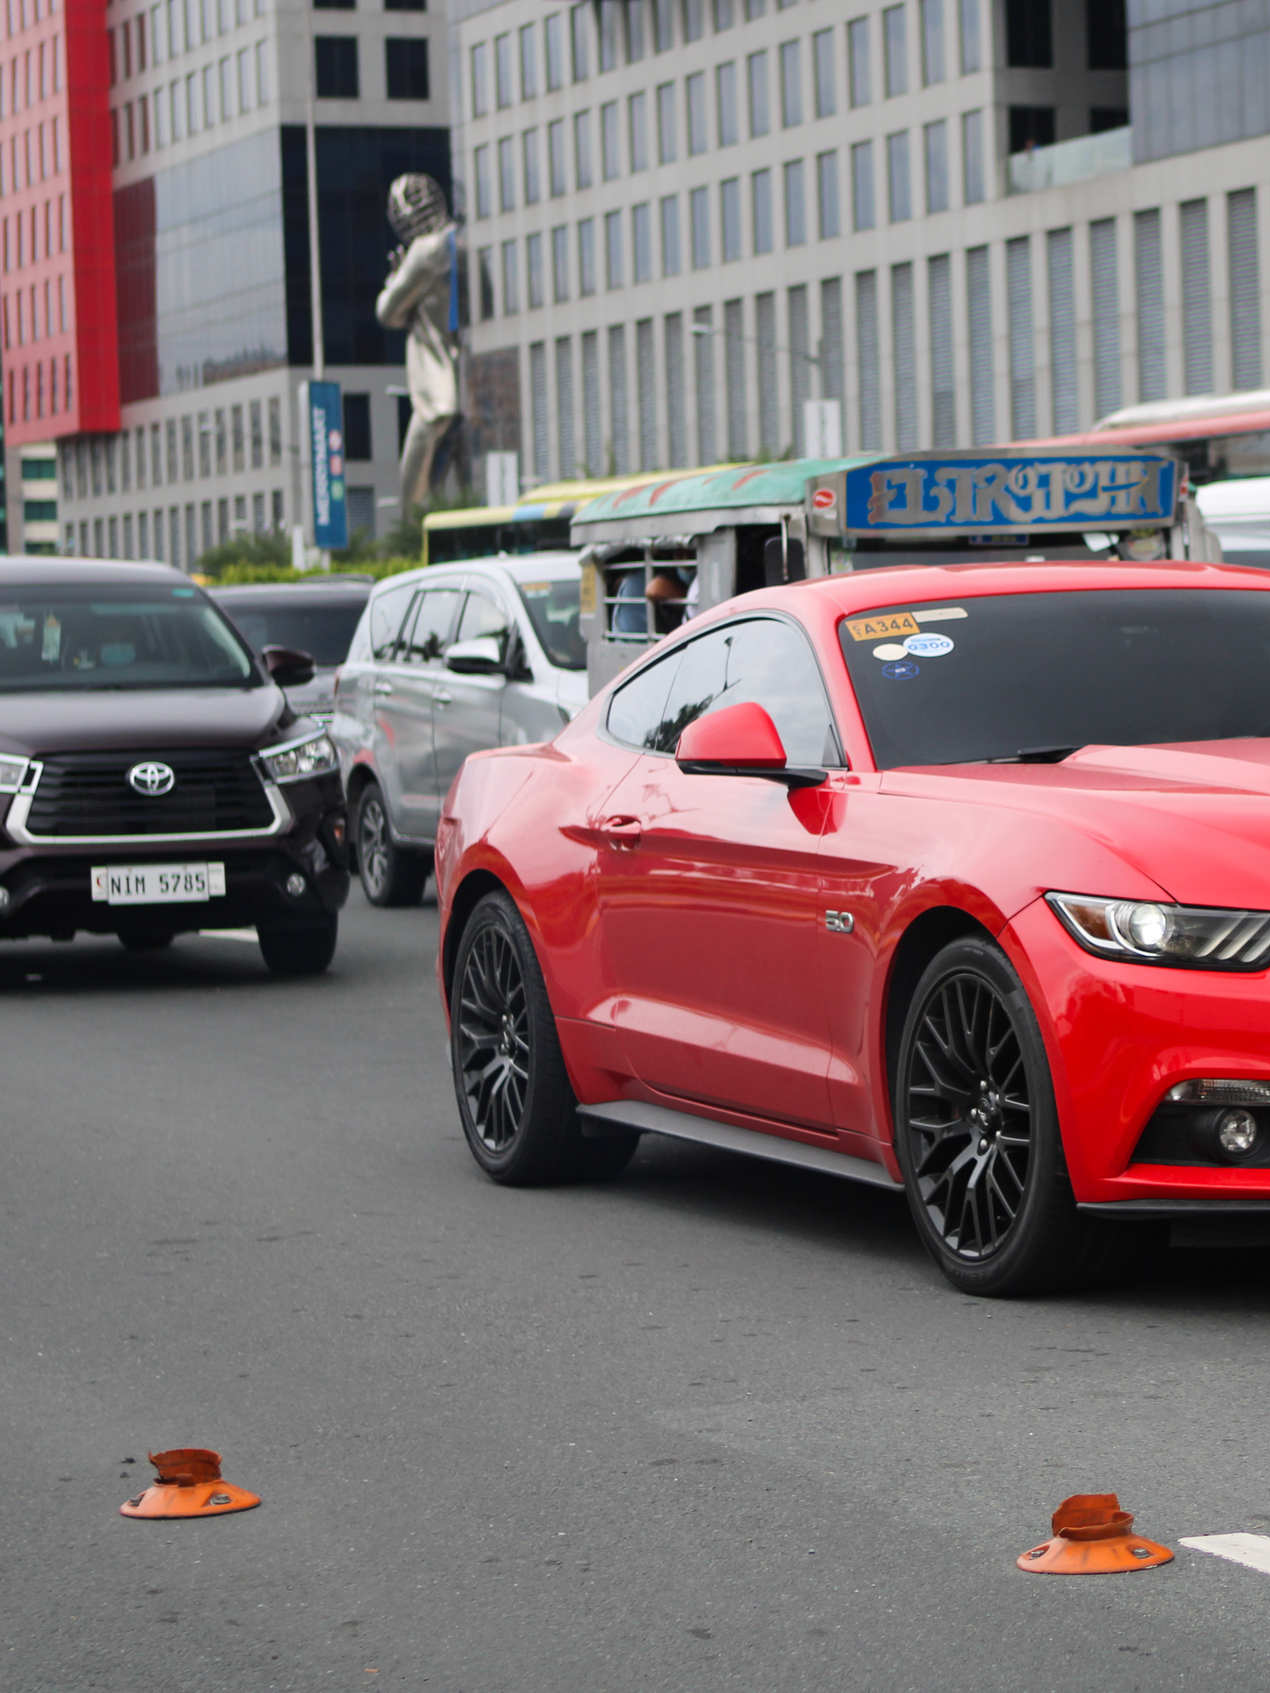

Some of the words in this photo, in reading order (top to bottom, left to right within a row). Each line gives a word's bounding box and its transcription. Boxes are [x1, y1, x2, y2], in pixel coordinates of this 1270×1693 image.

[864, 618, 914, 635] A344
[908, 641, 950, 651] 0300
[111, 875, 146, 895] NIM
[159, 873, 206, 893] 5785
